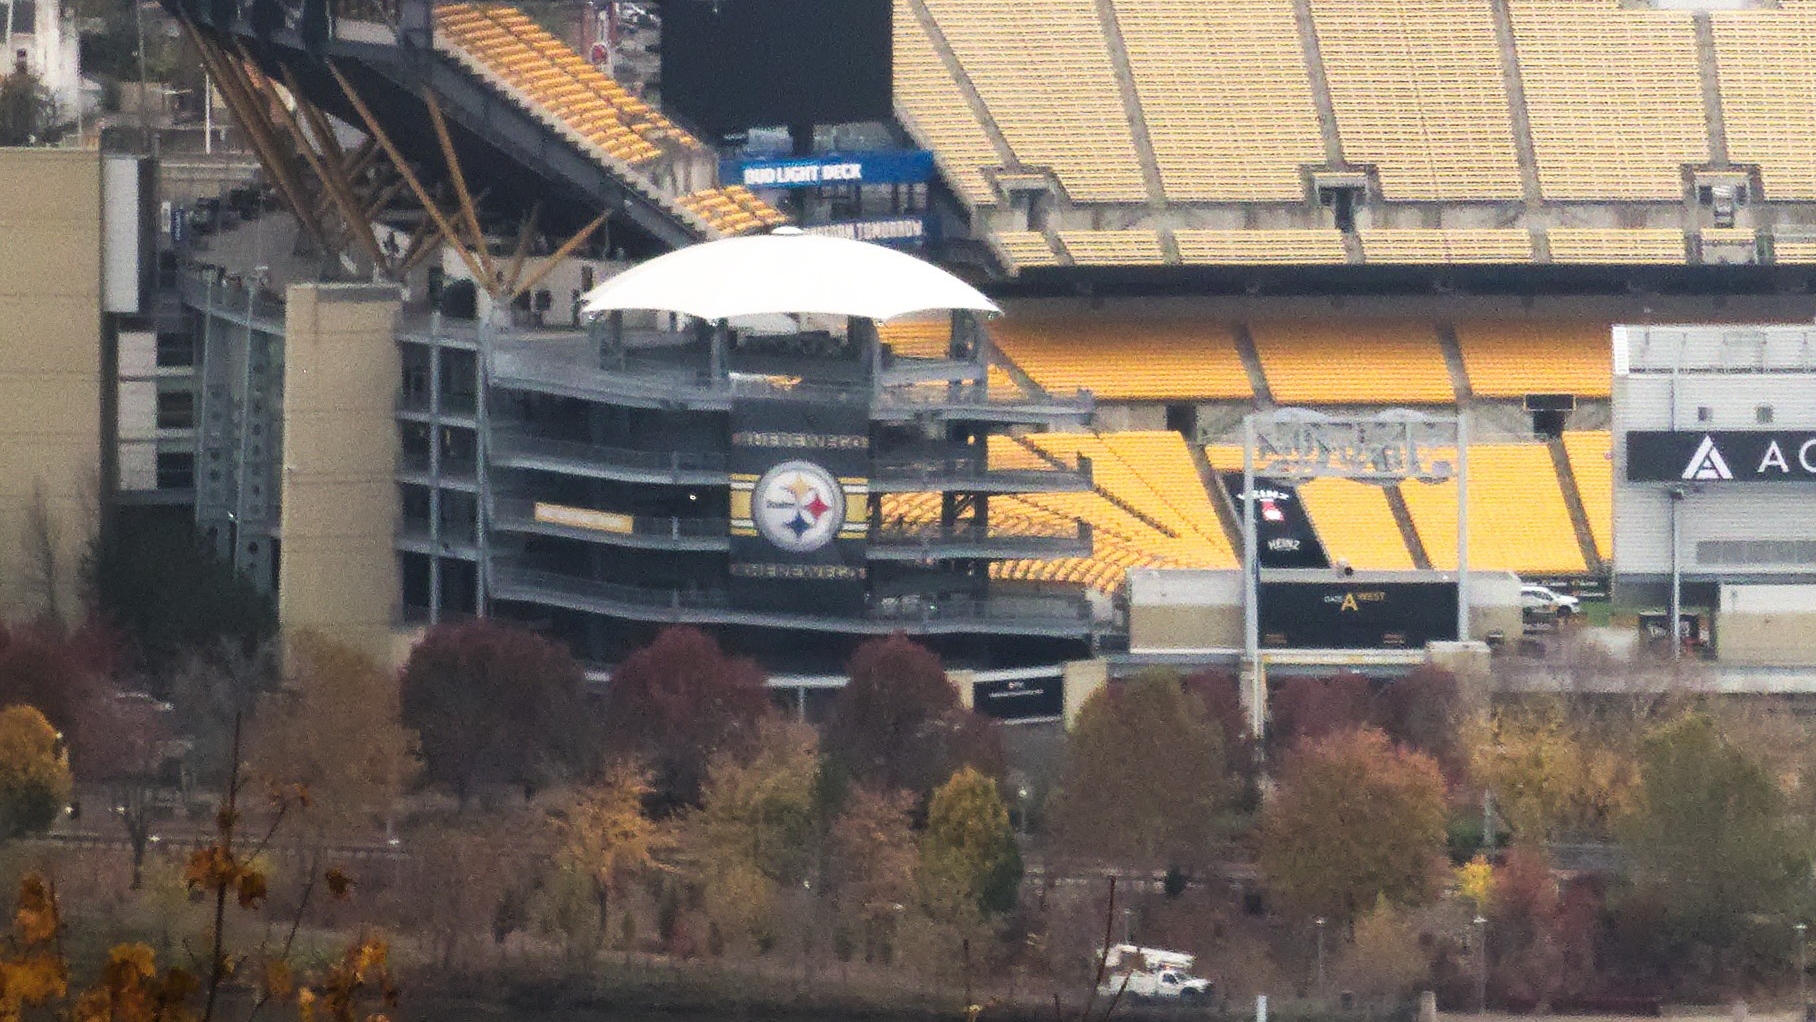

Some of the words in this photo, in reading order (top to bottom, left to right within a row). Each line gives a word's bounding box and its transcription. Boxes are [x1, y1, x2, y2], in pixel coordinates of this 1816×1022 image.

[743, 167, 776, 185] BUD
[776, 165, 819, 184] LIGHT
[823, 163, 862, 180] DECK
[1268, 538, 1300, 551] HEINZ
[1341, 593, 1358, 611] A
[1359, 592, 1384, 601] WEST
